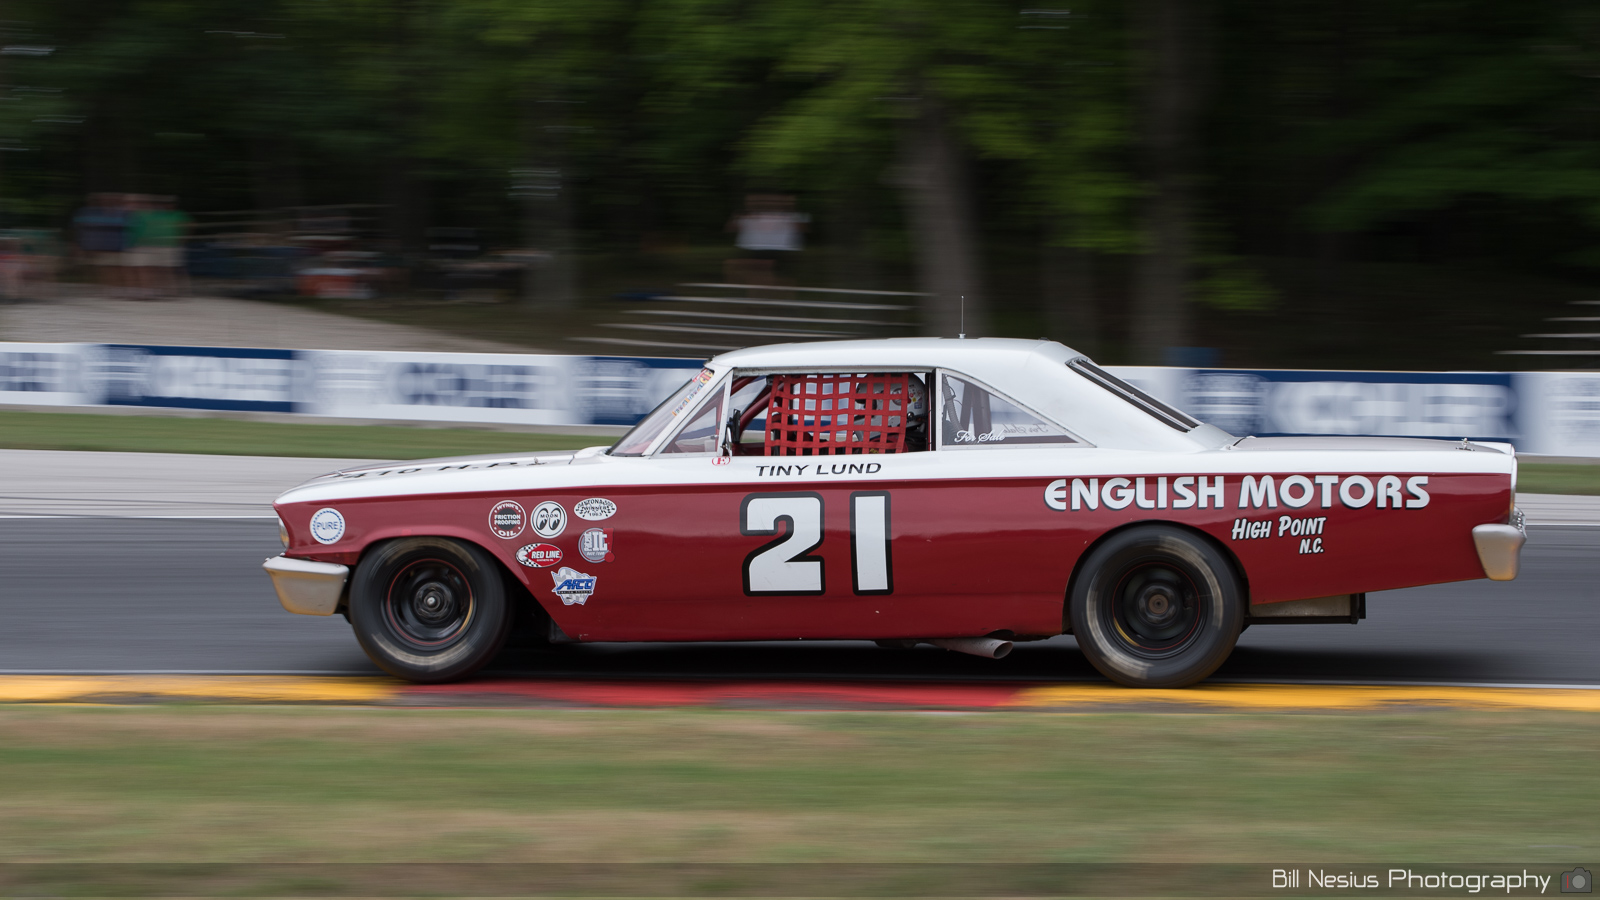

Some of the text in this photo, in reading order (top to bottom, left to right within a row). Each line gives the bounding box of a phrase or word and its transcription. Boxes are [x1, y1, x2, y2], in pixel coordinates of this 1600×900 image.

[954, 429, 1005, 443] For Sale
[755, 462, 882, 477] TINY LUND
[1044, 474, 1431, 511] ENGLISH MOTORS
[316, 521, 338, 531] PURE
[1278, 516, 1326, 538] POINT
[740, 491, 894, 596] 21
[1299, 538, 1324, 555] N.C.
[531, 550, 560, 559] RED LINE
